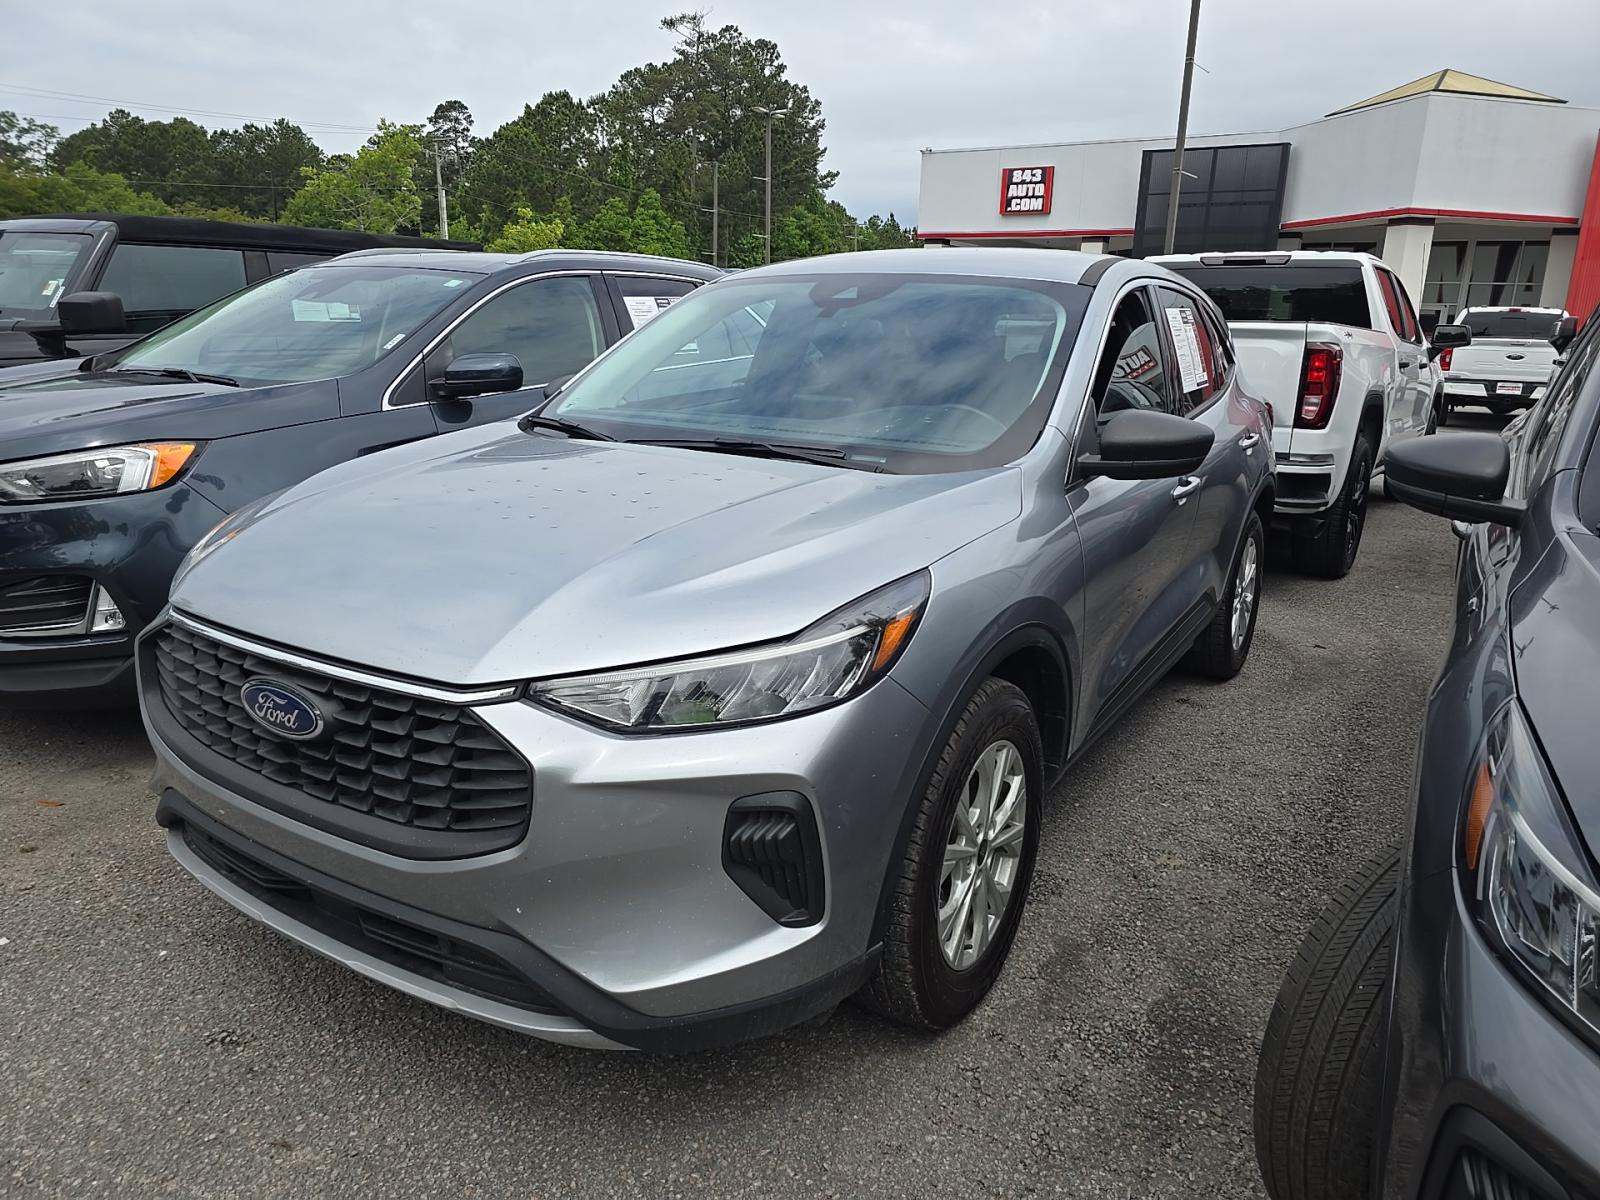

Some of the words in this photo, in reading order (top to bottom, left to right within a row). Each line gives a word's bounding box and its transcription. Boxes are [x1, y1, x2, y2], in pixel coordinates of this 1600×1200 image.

[1012, 169, 1042, 182] 843
[1008, 183, 1045, 197] AUTO
[1007, 198, 1043, 211] .COM
[255, 691, 299, 729] Ford
